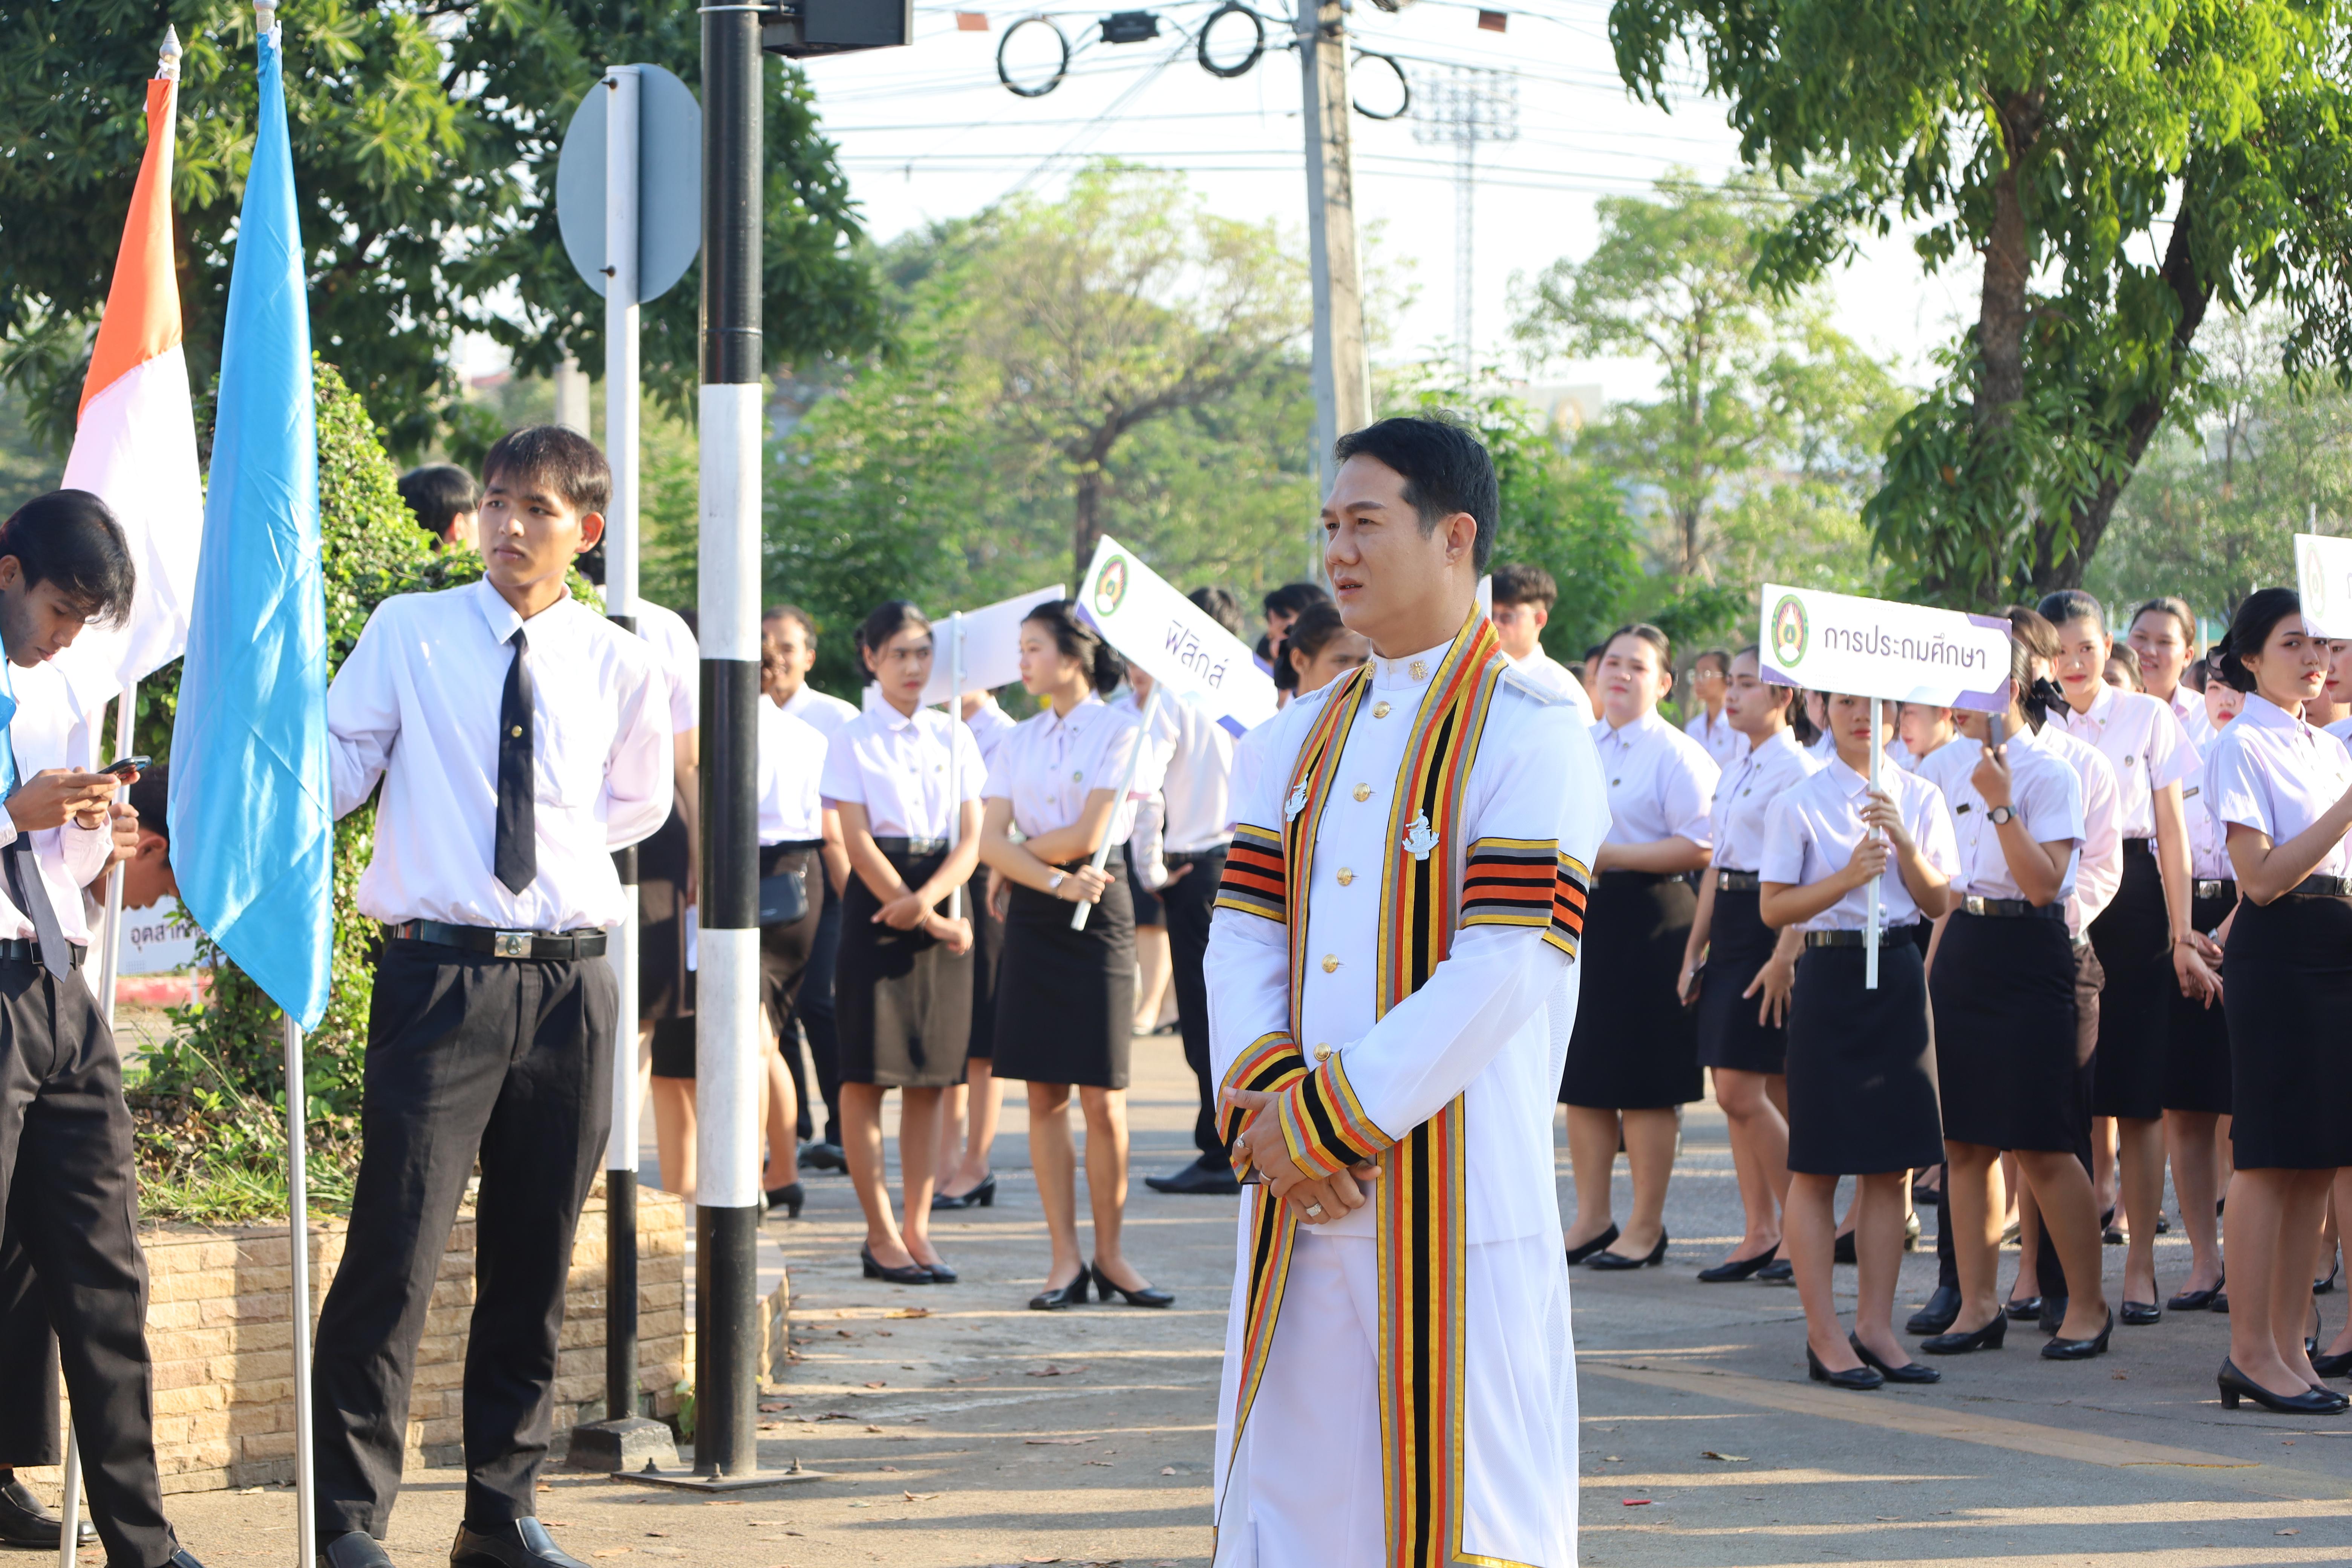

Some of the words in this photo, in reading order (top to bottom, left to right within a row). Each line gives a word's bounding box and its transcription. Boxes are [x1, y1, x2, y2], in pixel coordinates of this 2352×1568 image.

[1165, 619, 1229, 689] ฟิสิกส์
[1825, 625, 1985, 670] การประถมศึกษา
